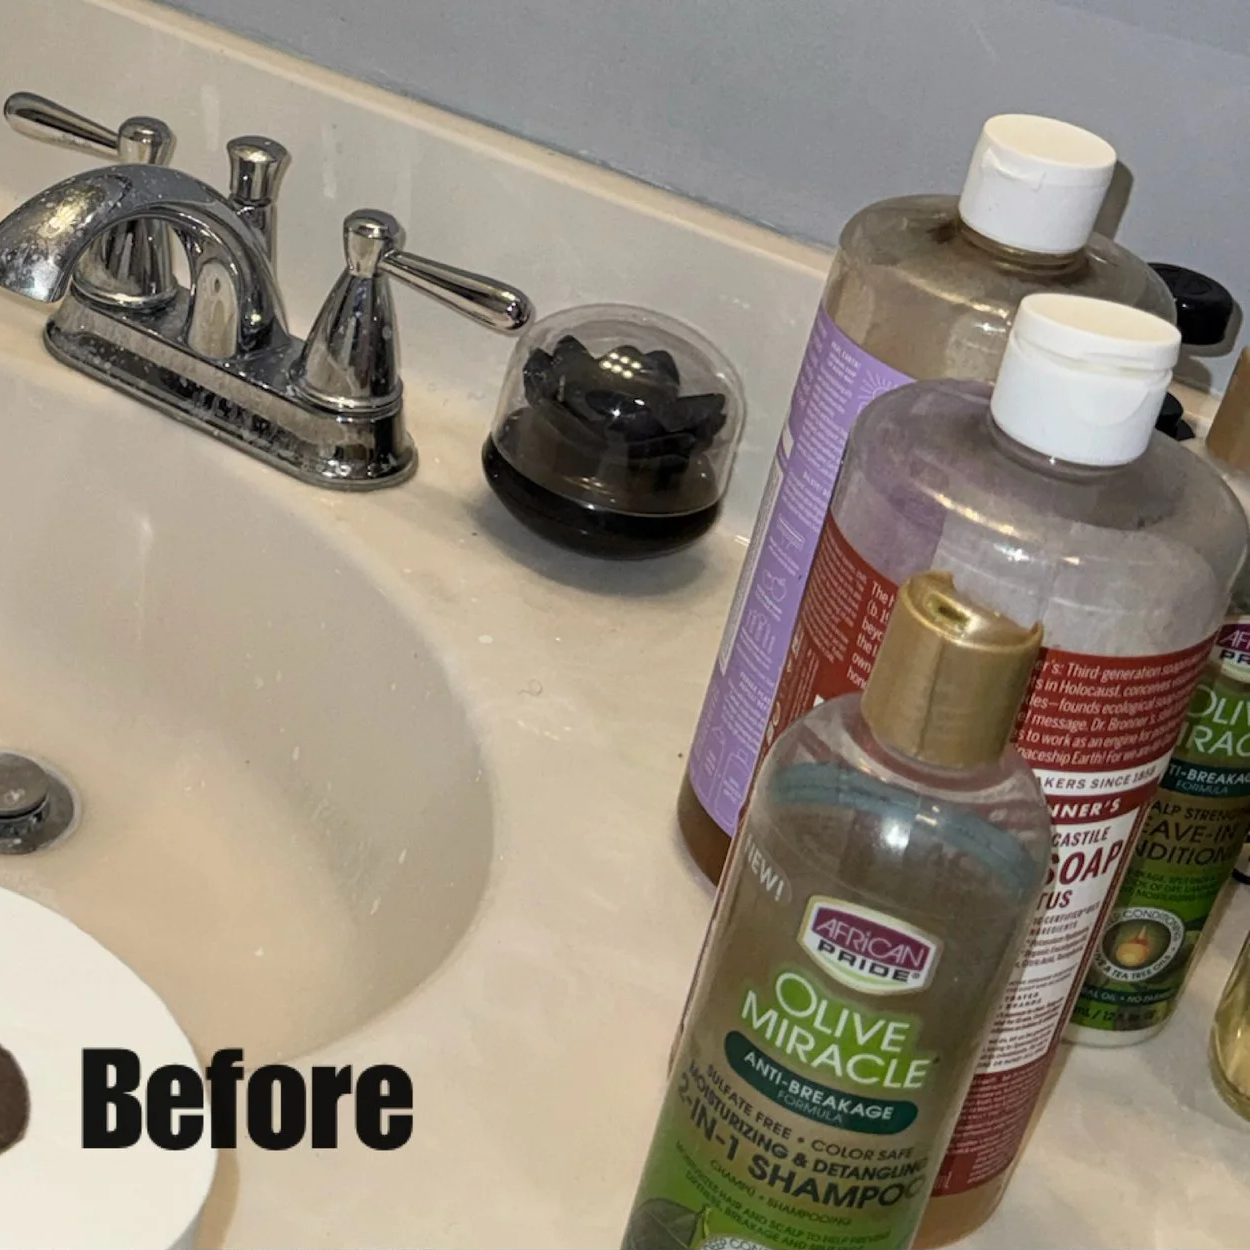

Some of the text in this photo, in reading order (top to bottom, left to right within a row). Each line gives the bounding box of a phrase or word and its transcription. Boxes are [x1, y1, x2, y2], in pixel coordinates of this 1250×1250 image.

[1045, 681, 1058, 692] in
[1026, 731, 1040, 743] to
[1042, 733, 1070, 746] work
[1072, 735, 1086, 747] as
[1088, 736, 1101, 747] an
[1089, 774, 1132, 789] SINCE
[1052, 826, 1111, 847] CASTILE
[775, 972, 911, 1053] OLIVE
[742, 990, 931, 1089] MIRACLE
[744, 1052, 895, 1120] ANTI-BREAKAGE
[777, 1090, 843, 1124] FORMULA
[689, 1060, 928, 1181] MOISTURIZING & DETANGLING
[706, 1064, 916, 1161] SULFATE FREE COLOR SAFE
[678, 1074, 927, 1209] 2-IN-1 SHAMPOO
[747, 1208, 767, 1225] AND
[770, 1219, 805, 1238] SCALP
[807, 1231, 821, 1242] TO
